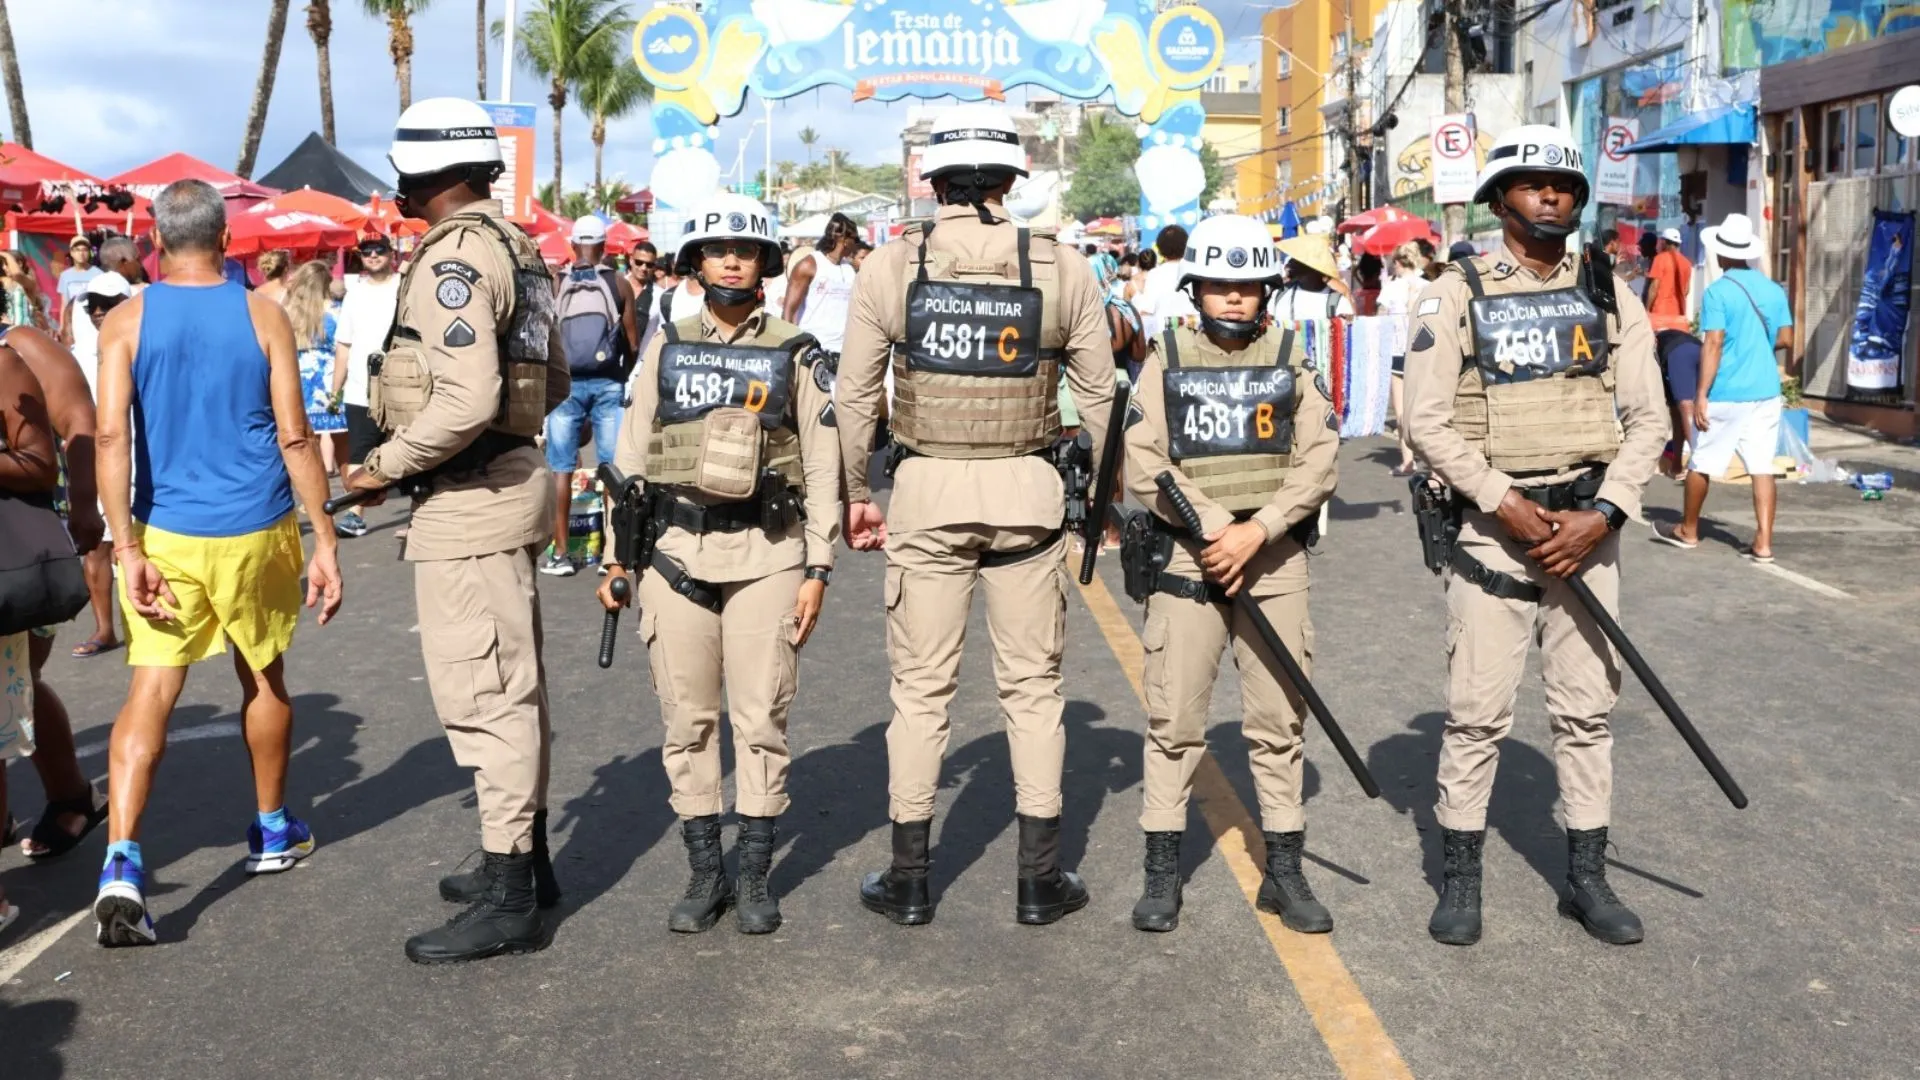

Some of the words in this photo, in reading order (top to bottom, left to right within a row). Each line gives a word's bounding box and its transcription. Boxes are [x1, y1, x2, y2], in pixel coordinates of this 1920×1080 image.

[890, 9, 940, 29] Festa
[943, 12, 963, 29] de
[450, 128, 482, 138] POLÍCIA
[977, 130, 1007, 140] MILITAR
[1445, 130, 1460, 152] E
[1522, 144, 1540, 163] P
[1564, 146, 1578, 170] M
[704, 212, 721, 233] P
[750, 214, 768, 236] M
[1205, 246, 1222, 267] P
[1253, 247, 1269, 268] M
[925, 296, 972, 315] POLÍCIA
[975, 301, 1022, 317] MILITAR
[1489, 306, 1538, 324] POLÍCIA
[1540, 302, 1586, 317] MILITAR
[922, 321, 986, 361] 4581
[998, 326, 1020, 363] C
[1494, 326, 1560, 366] 4581
[1572, 324, 1593, 361] A
[676, 351, 722, 368] POLÍCIA
[725, 358, 771, 372] MILITAR
[675, 372, 735, 409] 4581
[744, 380, 769, 413] D
[1180, 379, 1227, 397] POLÍCIA
[1229, 382, 1276, 397] MILITAR
[1184, 402, 1244, 440] 4581
[1256, 403, 1274, 438] B
